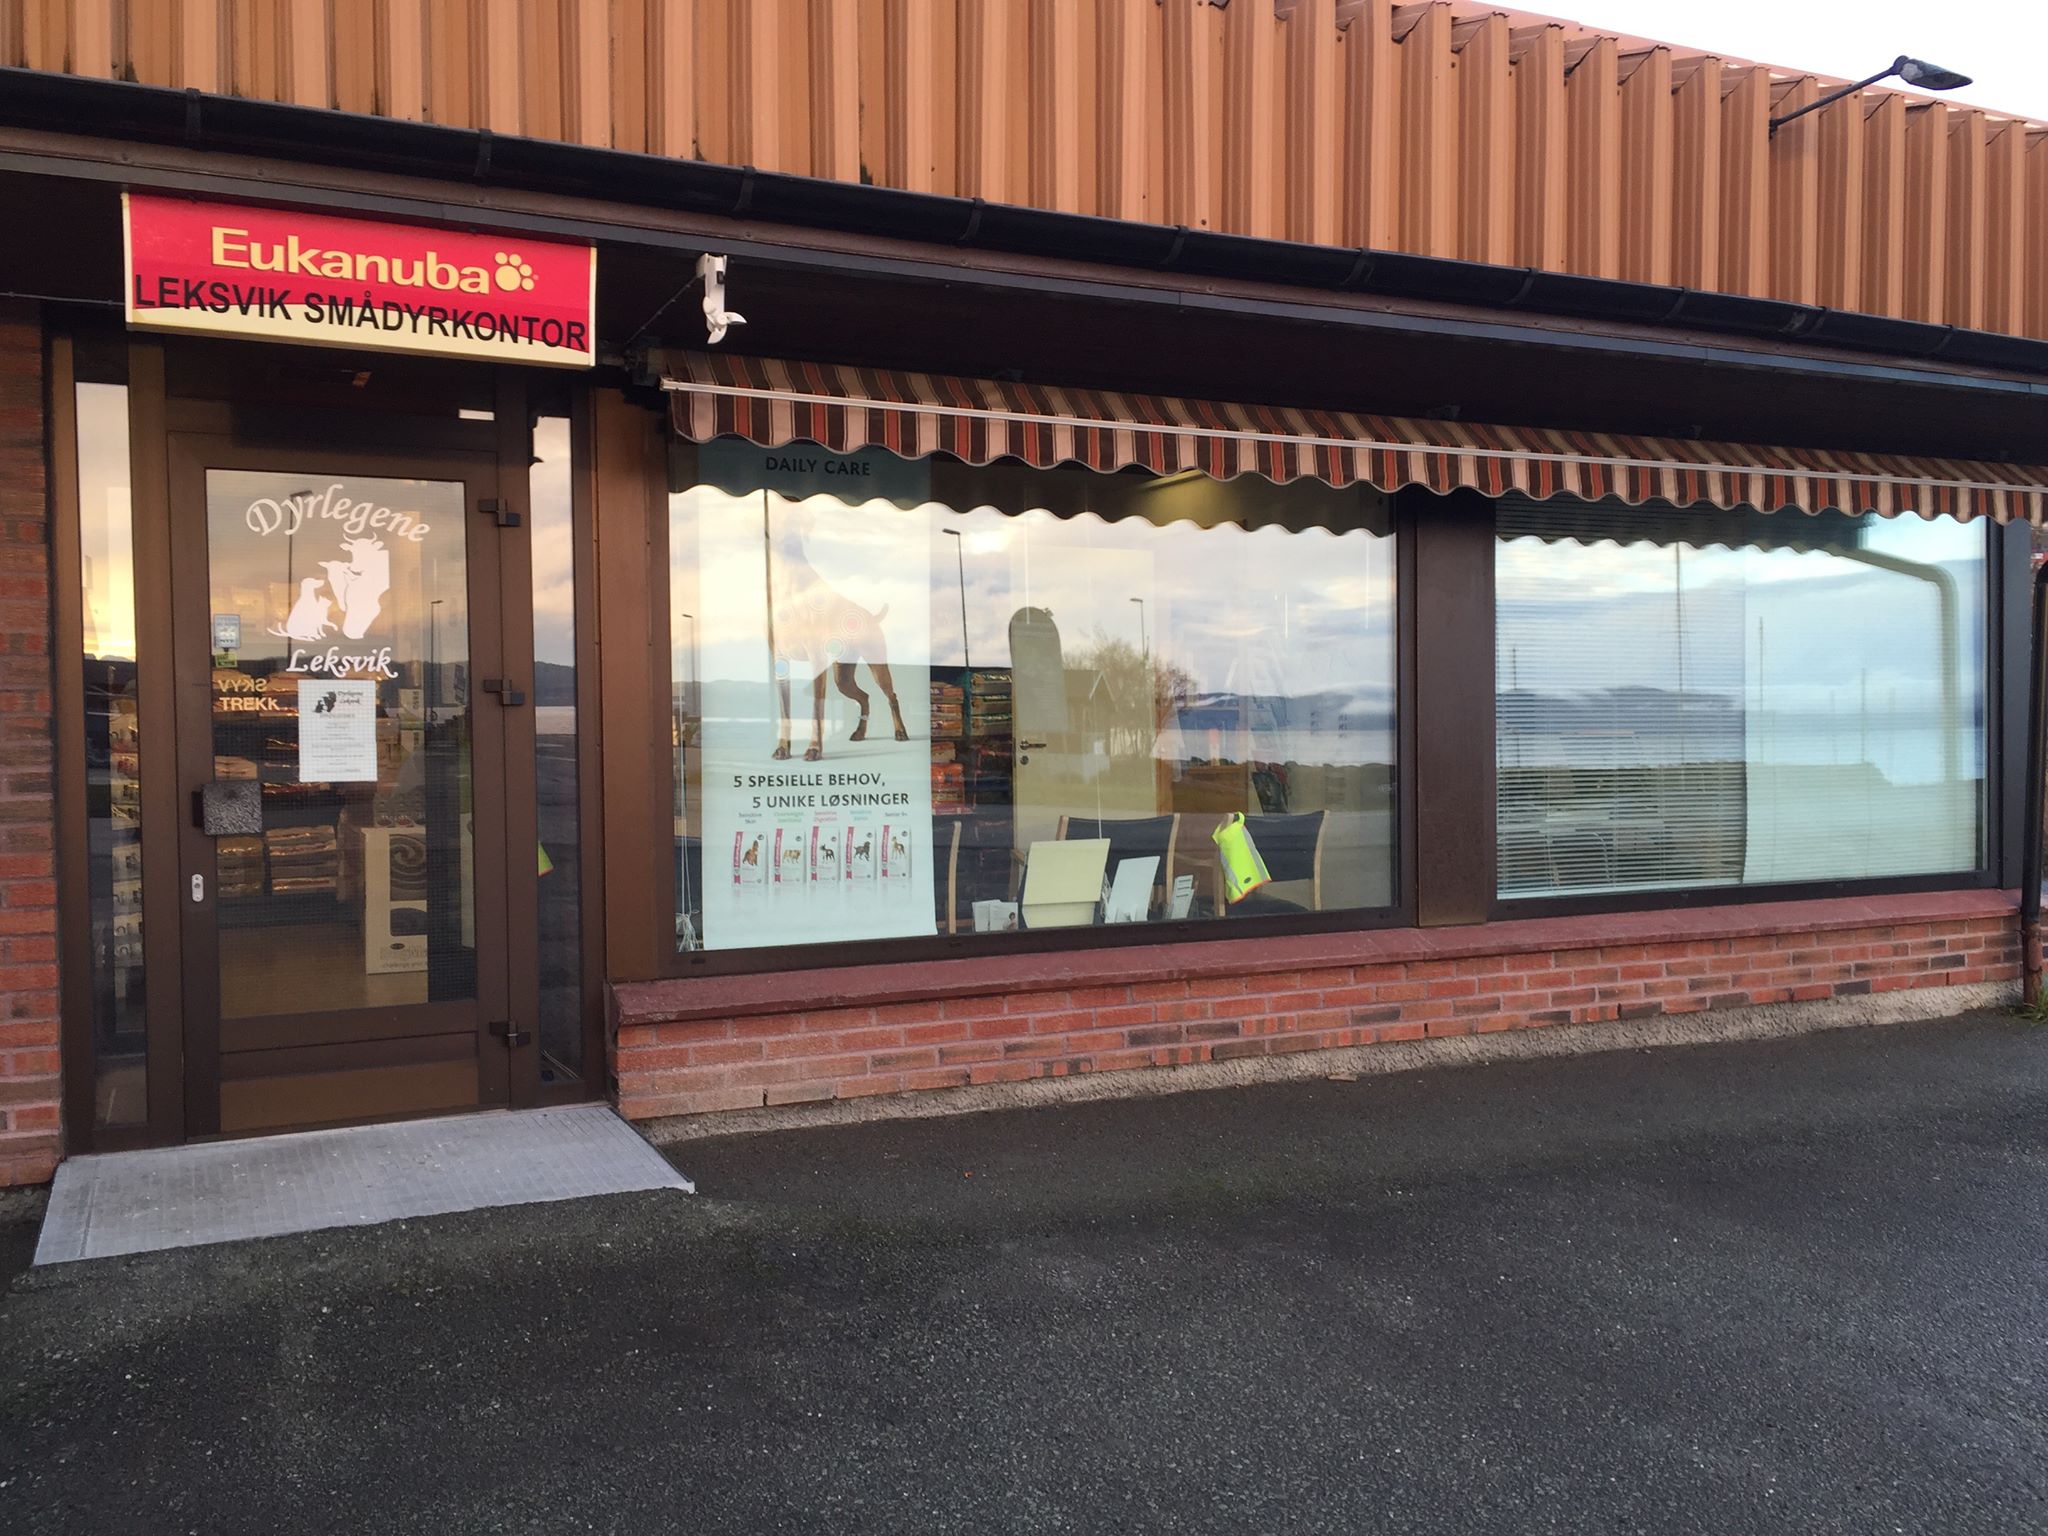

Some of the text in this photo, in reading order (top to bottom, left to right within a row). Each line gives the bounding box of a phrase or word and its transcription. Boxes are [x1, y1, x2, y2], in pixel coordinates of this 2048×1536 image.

[211, 226, 490, 295] Eukanuba
[135, 274, 586, 350] LEKSVIK SMÅDYRKONTOR
[766, 457, 871, 476] DAILY CARE
[245, 484, 431, 542] Dyrlegene
[286, 646, 398, 678] Leksvik
[219, 697, 280, 711] TREKK
[733, 773, 886, 788] 5 SPESIELLE BEHOV,
[752, 793, 909, 809] 5 UNIKE LØSNINGER
